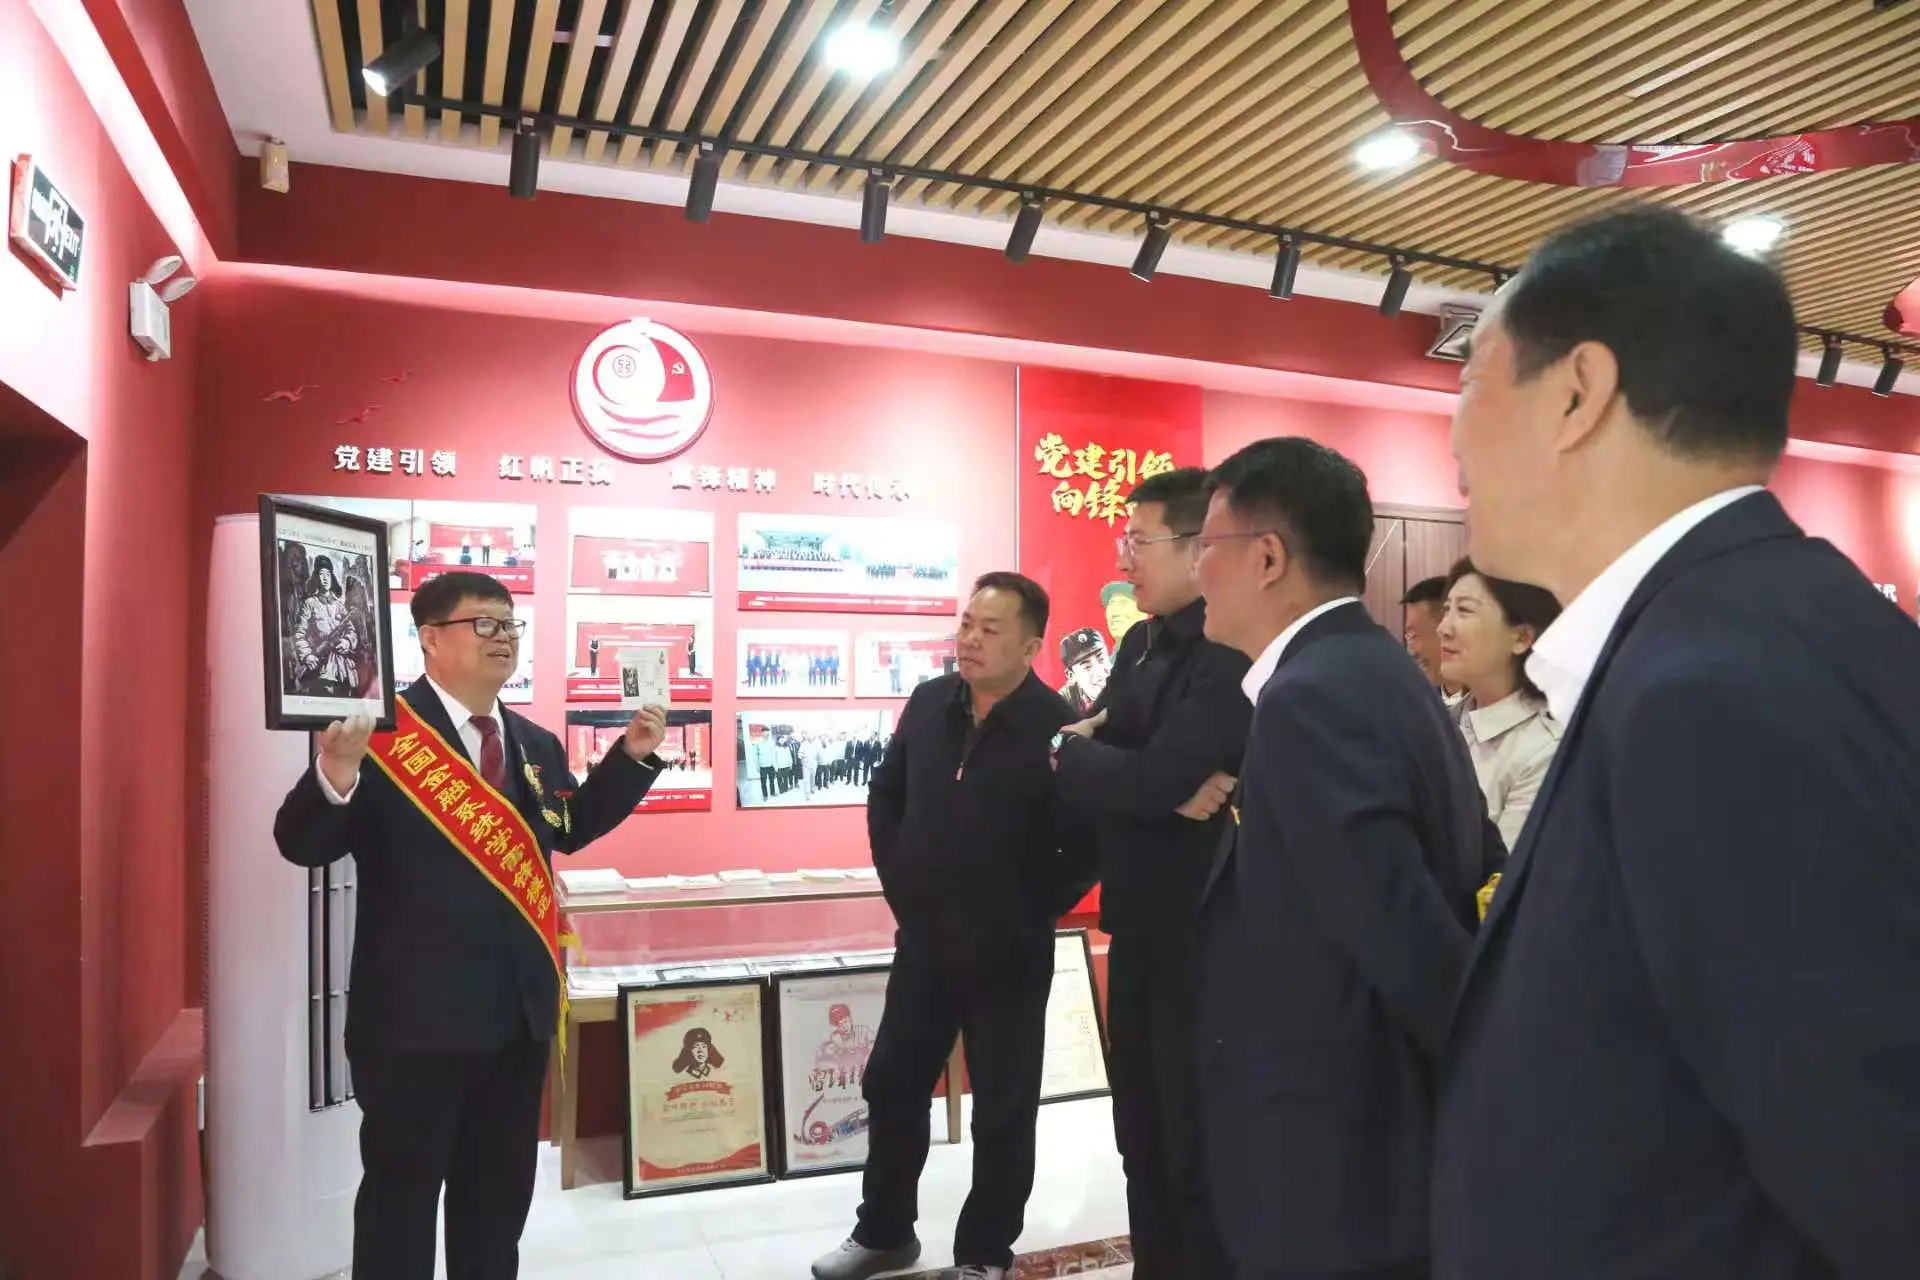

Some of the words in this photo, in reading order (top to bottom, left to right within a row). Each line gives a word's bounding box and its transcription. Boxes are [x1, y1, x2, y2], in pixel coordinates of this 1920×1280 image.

[334, 445, 457, 477] 党建引领
[1052, 478, 1138, 529] 向锋
[388, 732, 552, 919] 全国金融系统学雷锋模范
